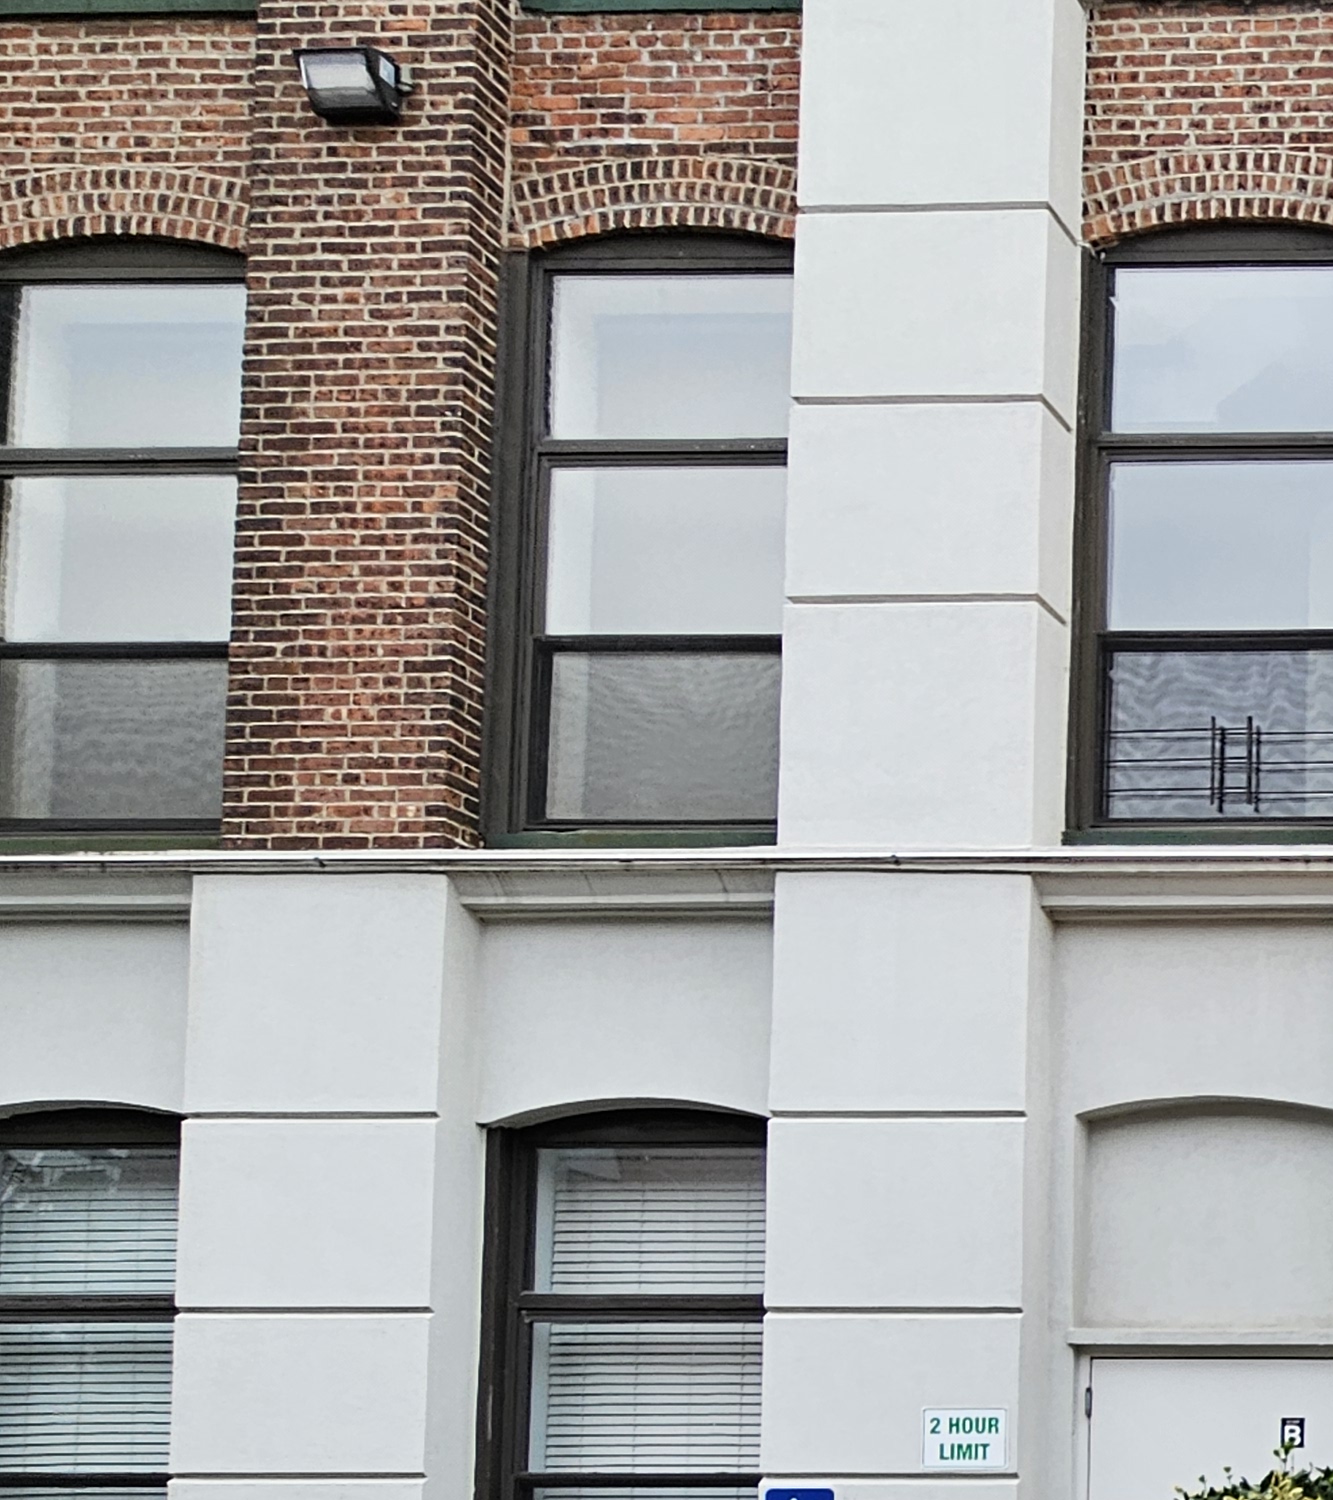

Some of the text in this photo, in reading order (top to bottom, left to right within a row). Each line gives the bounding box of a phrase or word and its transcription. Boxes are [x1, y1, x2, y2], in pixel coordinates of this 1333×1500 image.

[929, 1417, 1000, 1434] 2 HOUR
[1284, 1425, 1302, 1446] B
[939, 1443, 990, 1460] LIMIT
